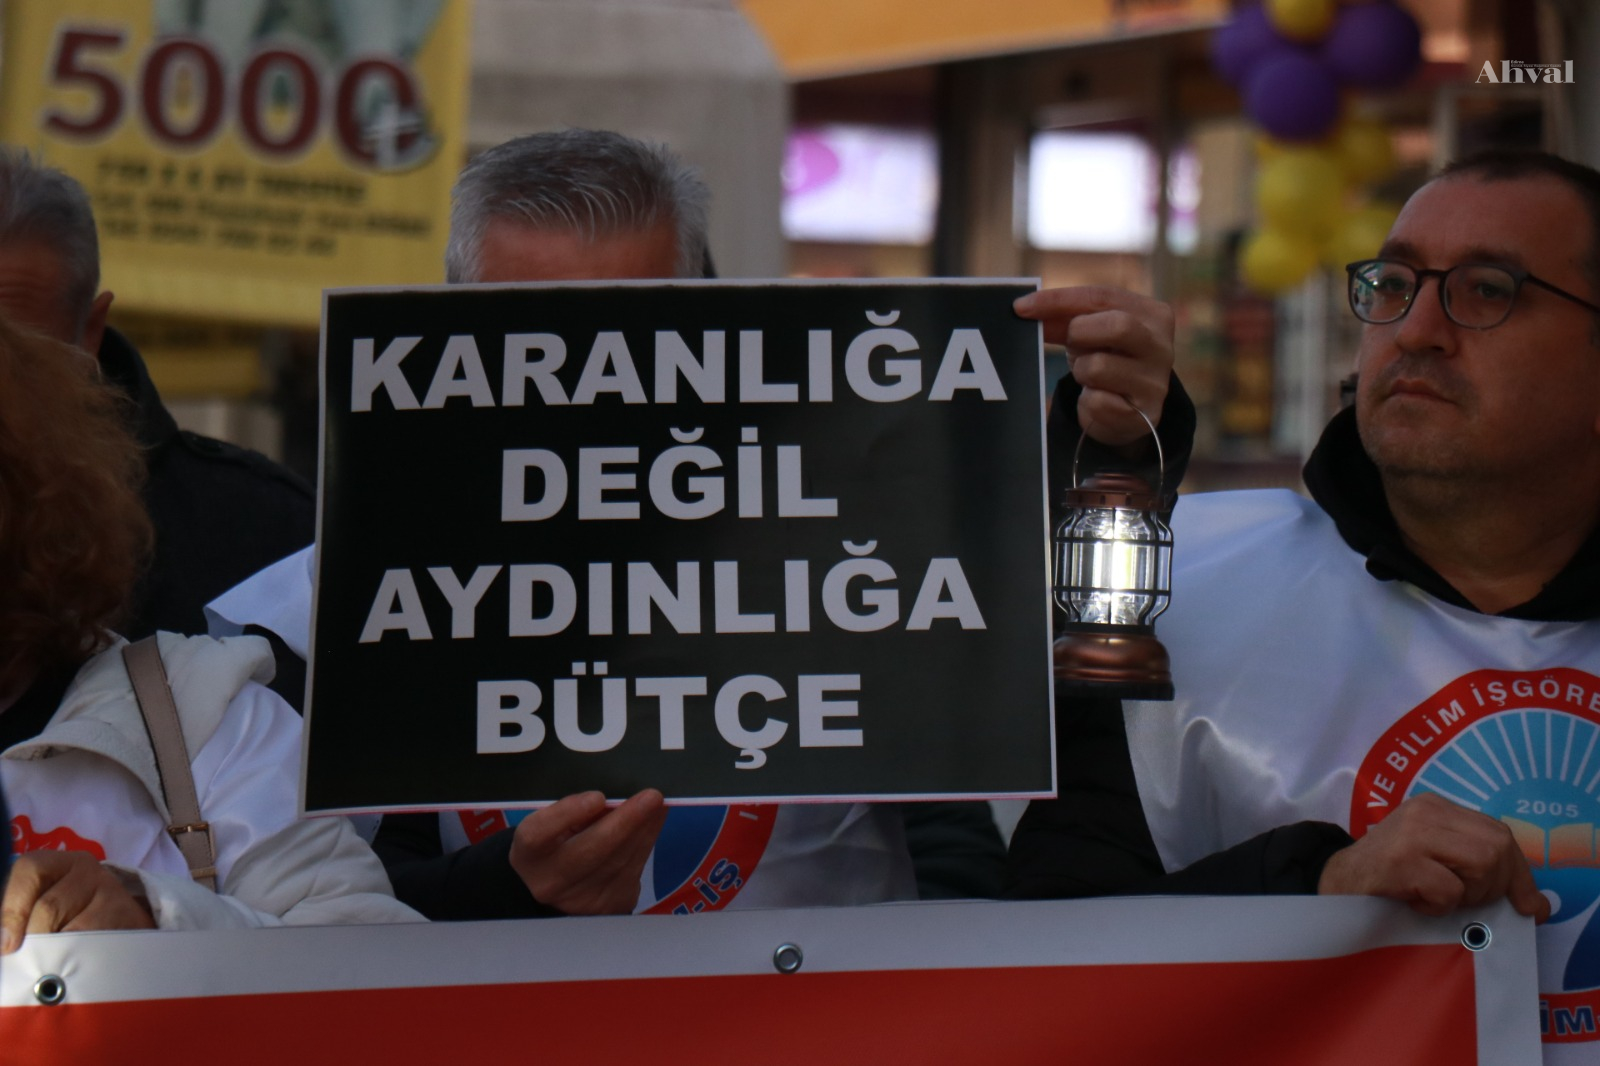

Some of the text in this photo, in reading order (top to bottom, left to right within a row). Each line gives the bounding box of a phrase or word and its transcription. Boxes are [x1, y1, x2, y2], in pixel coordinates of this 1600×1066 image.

[351, 310, 1008, 412] KARANLIĞA
[501, 427, 838, 521] DEĞİL
[359, 540, 987, 643] AYDINLIĞA
[476, 661, 864, 769] BÜTÇE
[1366, 773, 1396, 809] VE
[1386, 698, 1466, 772] BİLİM
[1516, 799, 1579, 818] 2005
